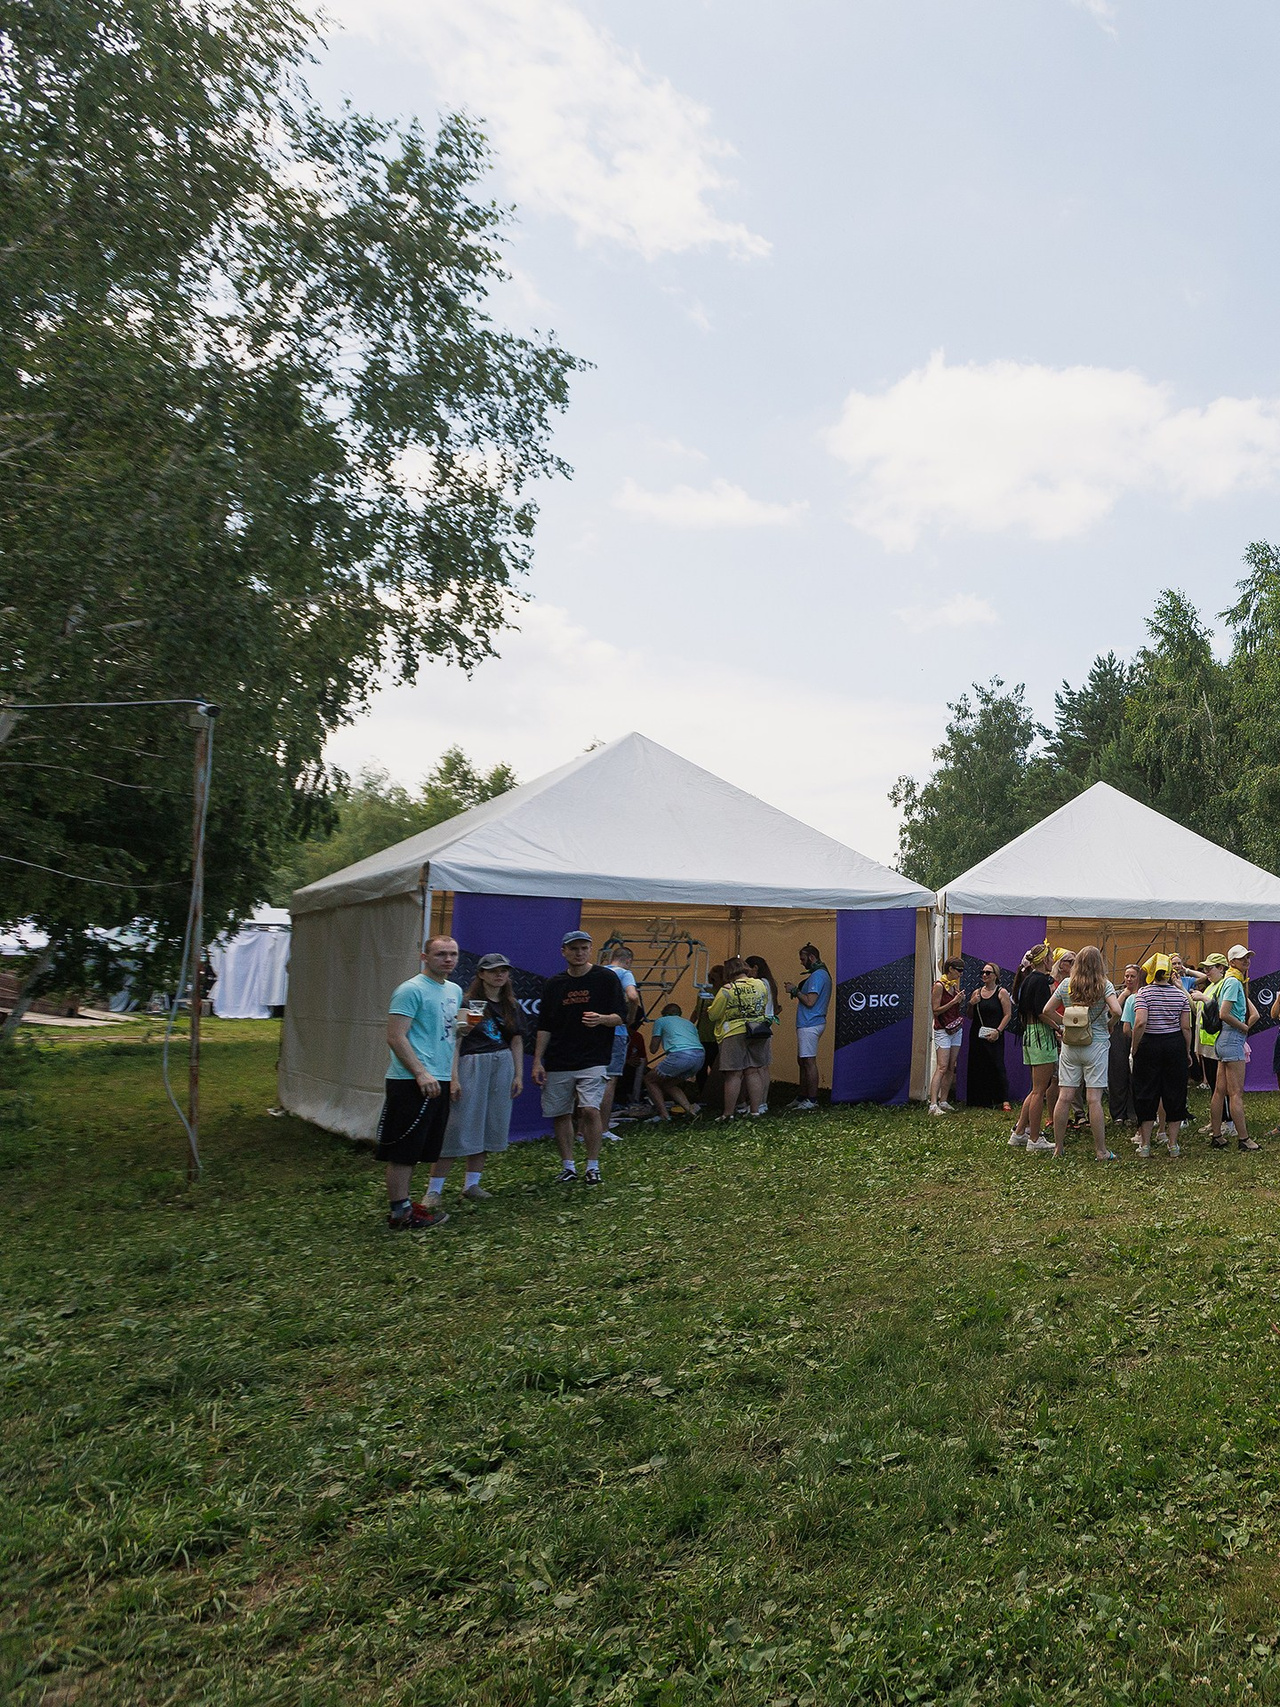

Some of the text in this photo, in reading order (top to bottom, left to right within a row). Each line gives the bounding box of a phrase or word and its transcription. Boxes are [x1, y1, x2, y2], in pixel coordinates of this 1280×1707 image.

[567, 990, 590, 998] GOOD
[869, 993, 900, 1008] БКС
[517, 998, 542, 1015] КС
